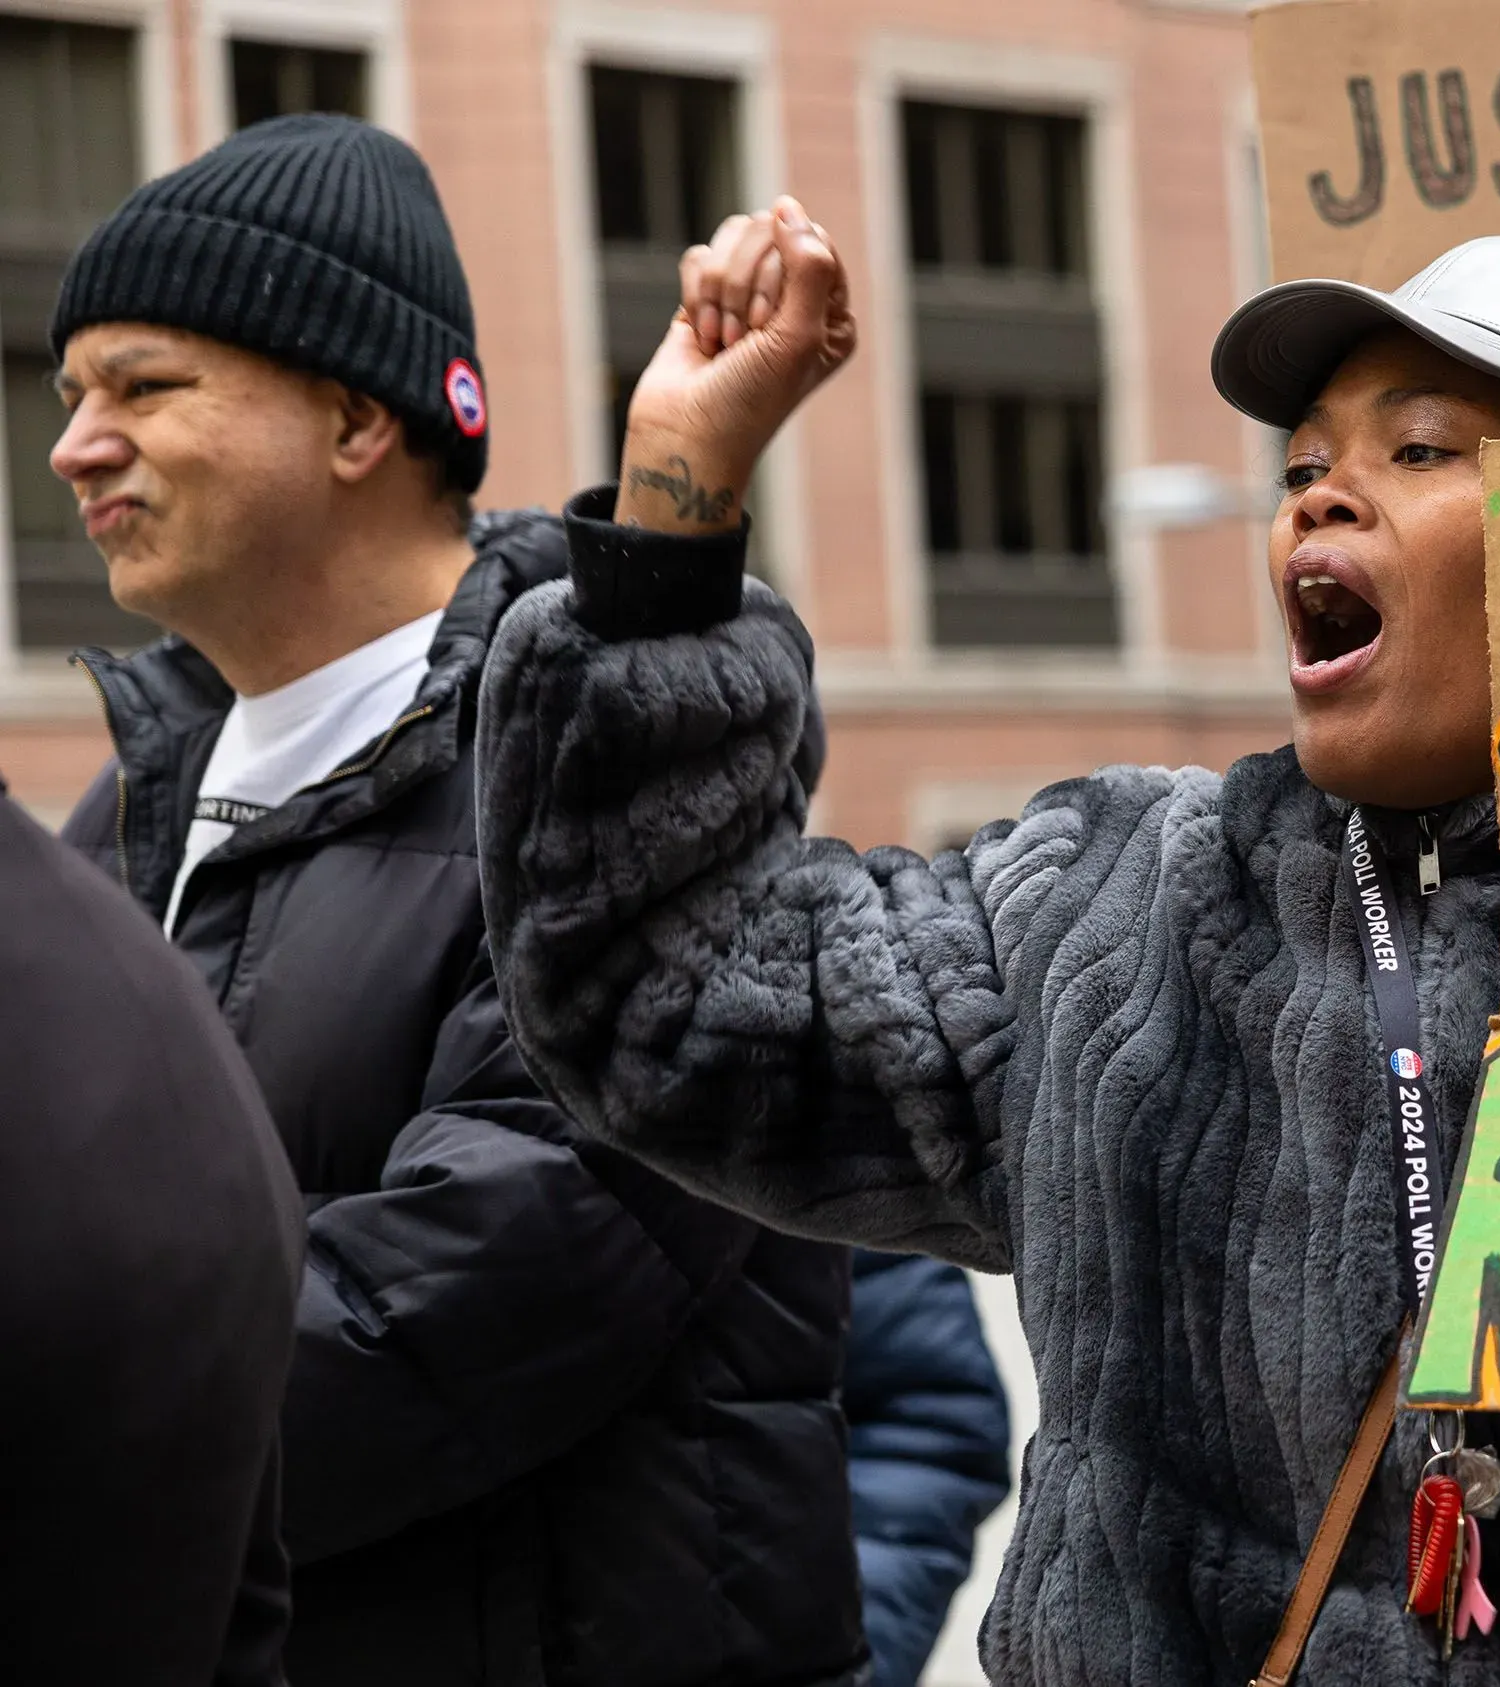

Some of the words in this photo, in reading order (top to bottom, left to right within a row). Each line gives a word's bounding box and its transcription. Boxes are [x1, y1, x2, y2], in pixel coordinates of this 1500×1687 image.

[1350, 839, 1377, 886] POLL
[1359, 884, 1399, 972] WORKER
[1399, 1085, 1427, 1152] 2024
[1405, 1156, 1432, 1220] POLL
